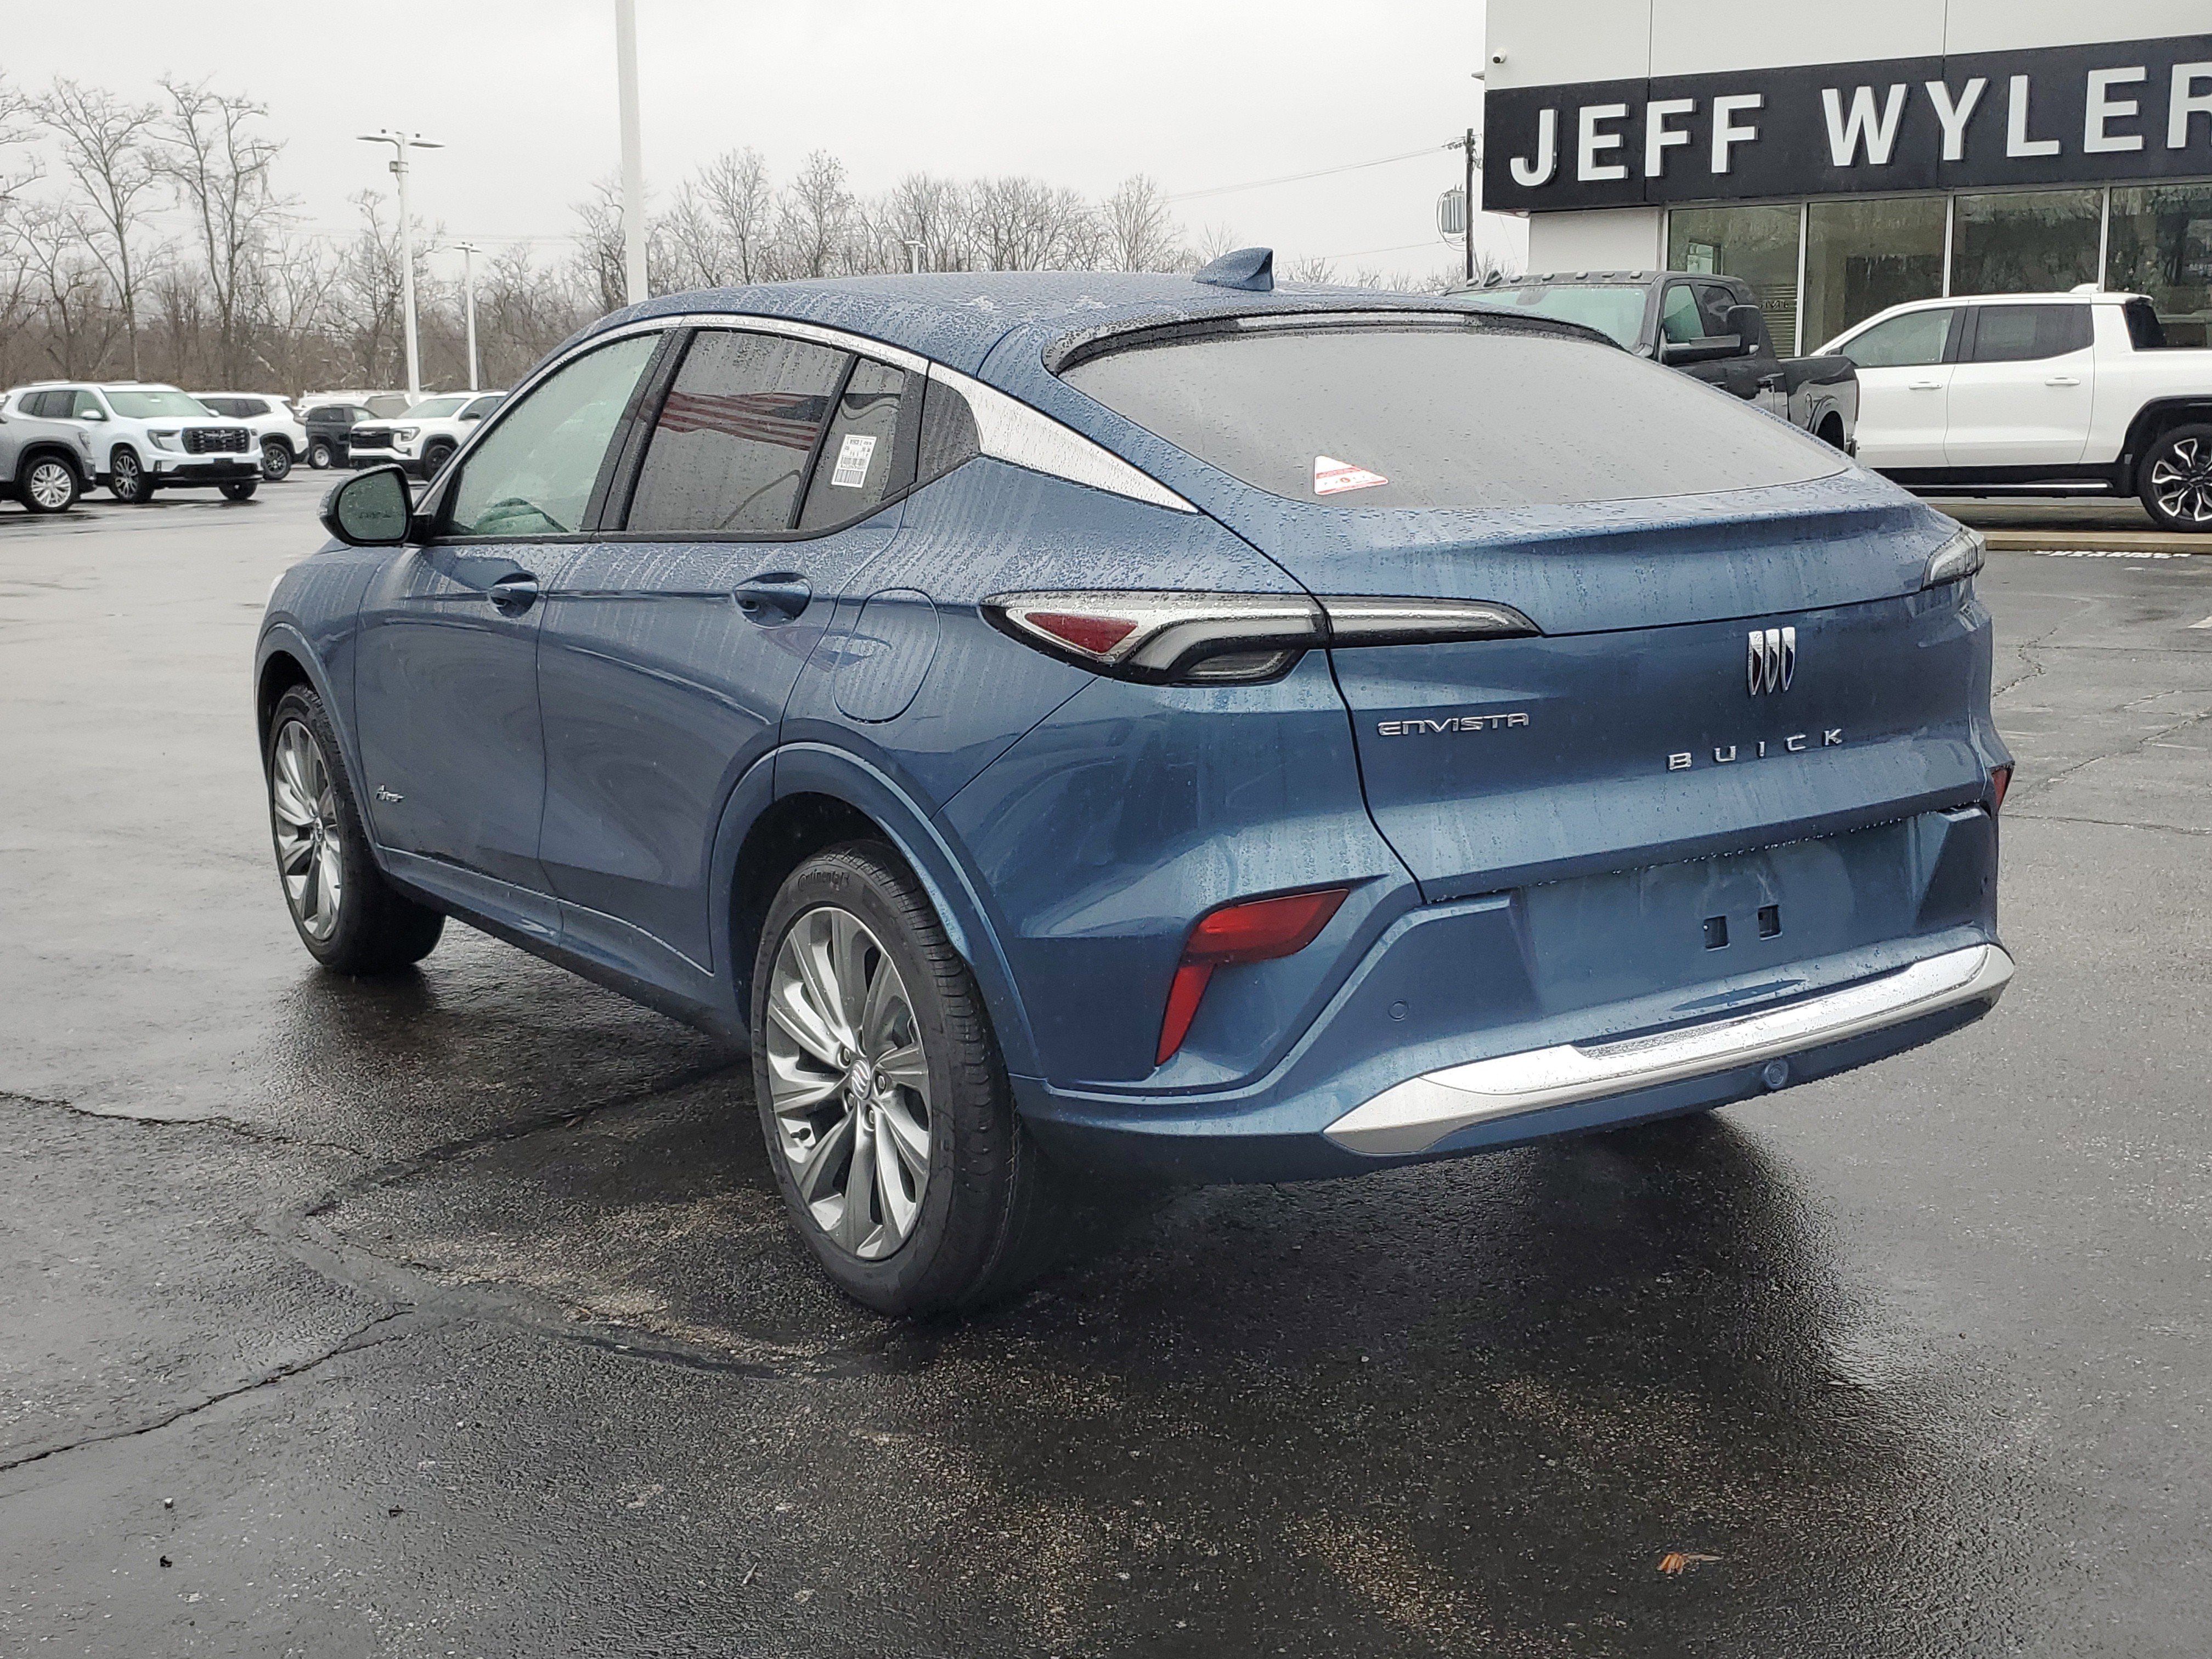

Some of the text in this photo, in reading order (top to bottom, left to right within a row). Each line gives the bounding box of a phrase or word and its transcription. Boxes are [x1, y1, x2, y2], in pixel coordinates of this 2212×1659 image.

[1510, 61, 2212, 187] JEFF WYLER
[1378, 713, 1530, 736] ENVISTA
[1668, 728, 1842, 770] BUICK
